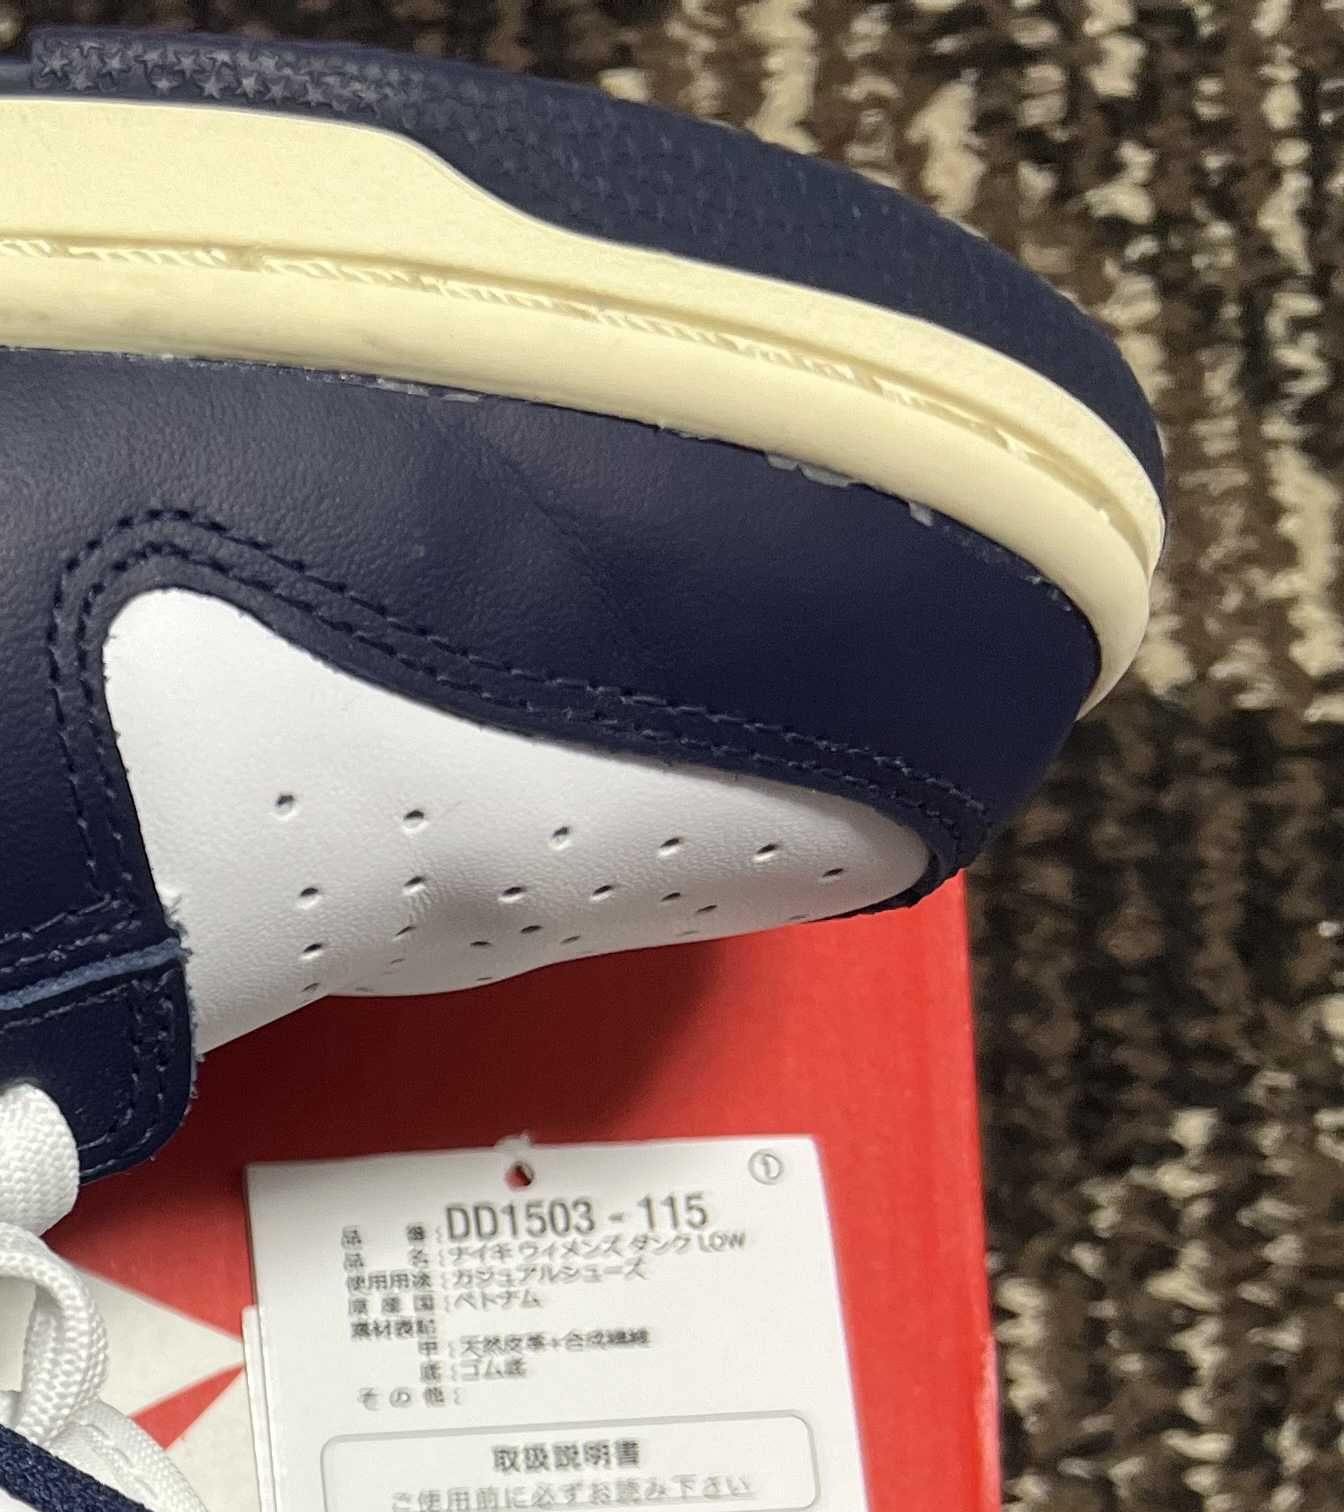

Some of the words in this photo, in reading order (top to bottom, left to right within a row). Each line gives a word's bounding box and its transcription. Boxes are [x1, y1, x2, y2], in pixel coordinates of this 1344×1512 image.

[698, 1230, 747, 1253] LOW
[492, 1439, 641, 1474] 取扱説明書
